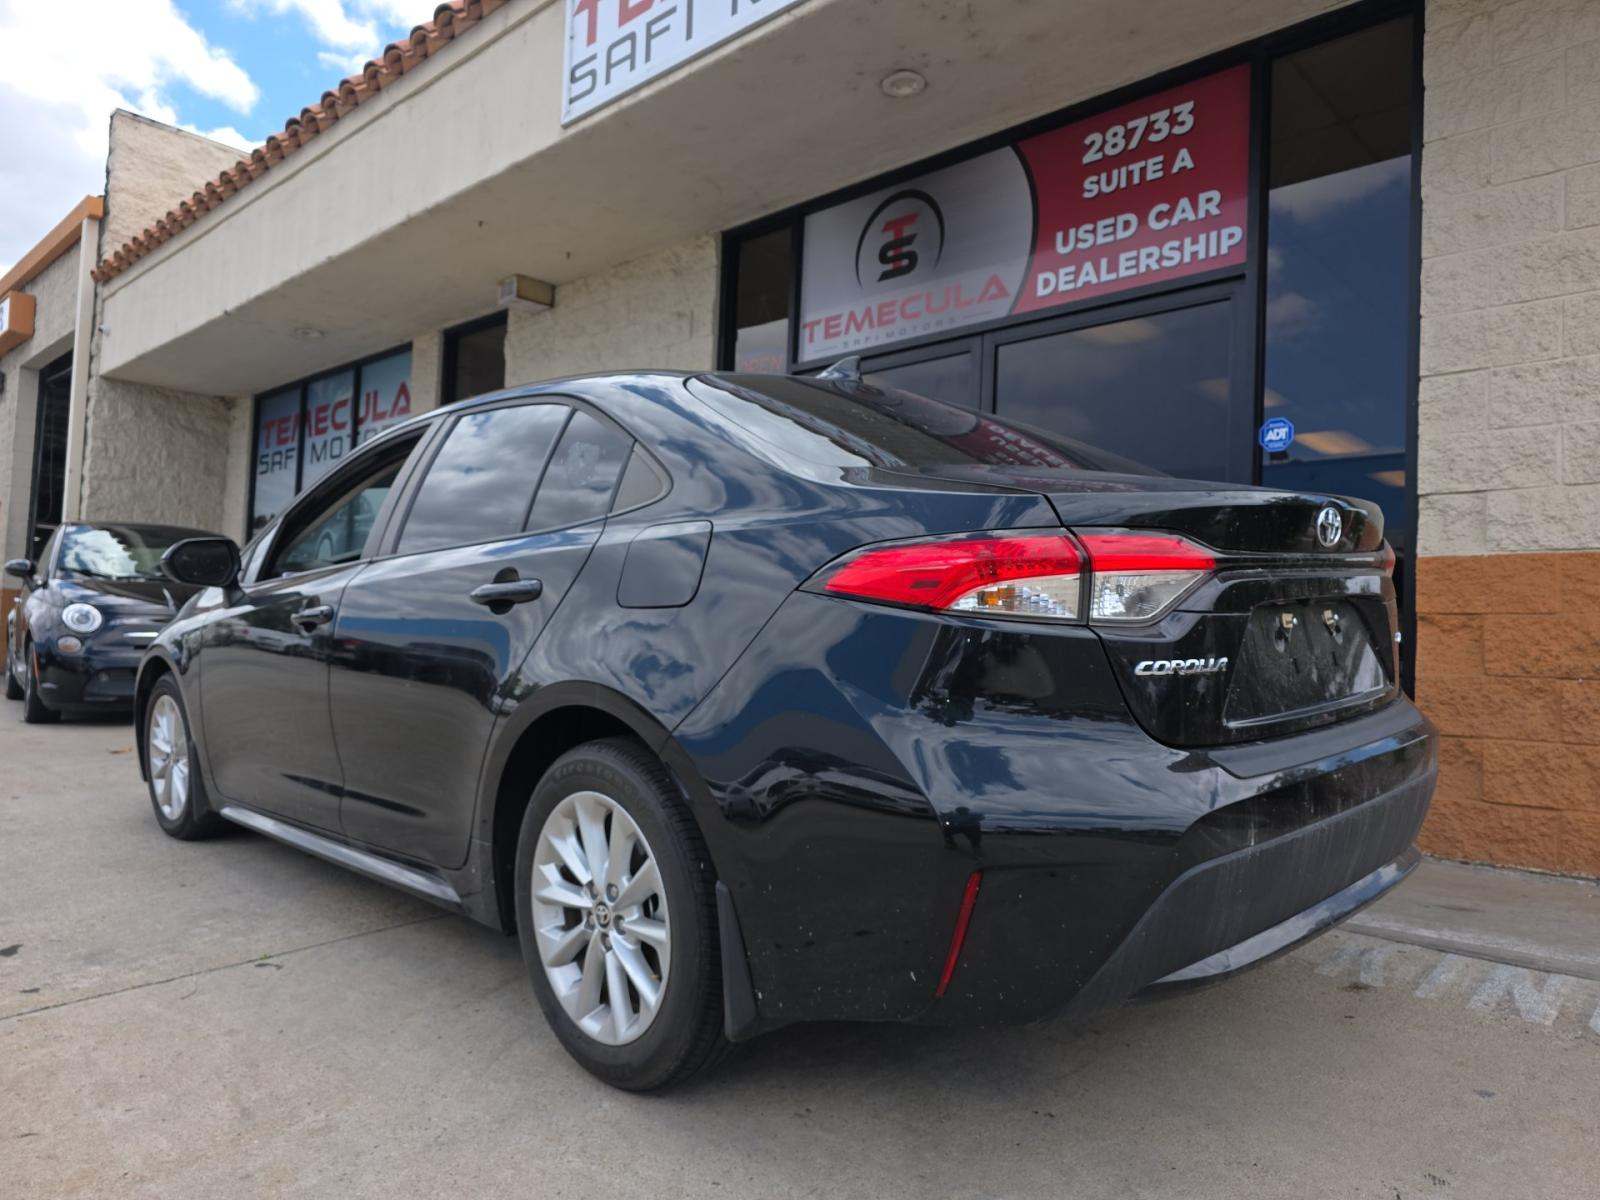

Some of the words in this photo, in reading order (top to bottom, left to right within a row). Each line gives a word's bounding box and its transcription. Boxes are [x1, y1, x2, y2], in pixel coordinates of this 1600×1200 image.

[1082, 100, 1195, 165] 28733
[1082, 155, 1164, 198] SUITE
[1172, 148, 1195, 174] A
[1056, 213, 1139, 255] USED
[1148, 189, 1222, 231] CAR
[1036, 226, 1243, 297] DEALERSHIP
[803, 274, 1010, 344] TEMECULA
[263, 381, 412, 449] TEMECULA
[1264, 428, 1289, 442] ADT
[258, 447, 297, 475] SAF
[1134, 657, 1229, 676] COROLLA
